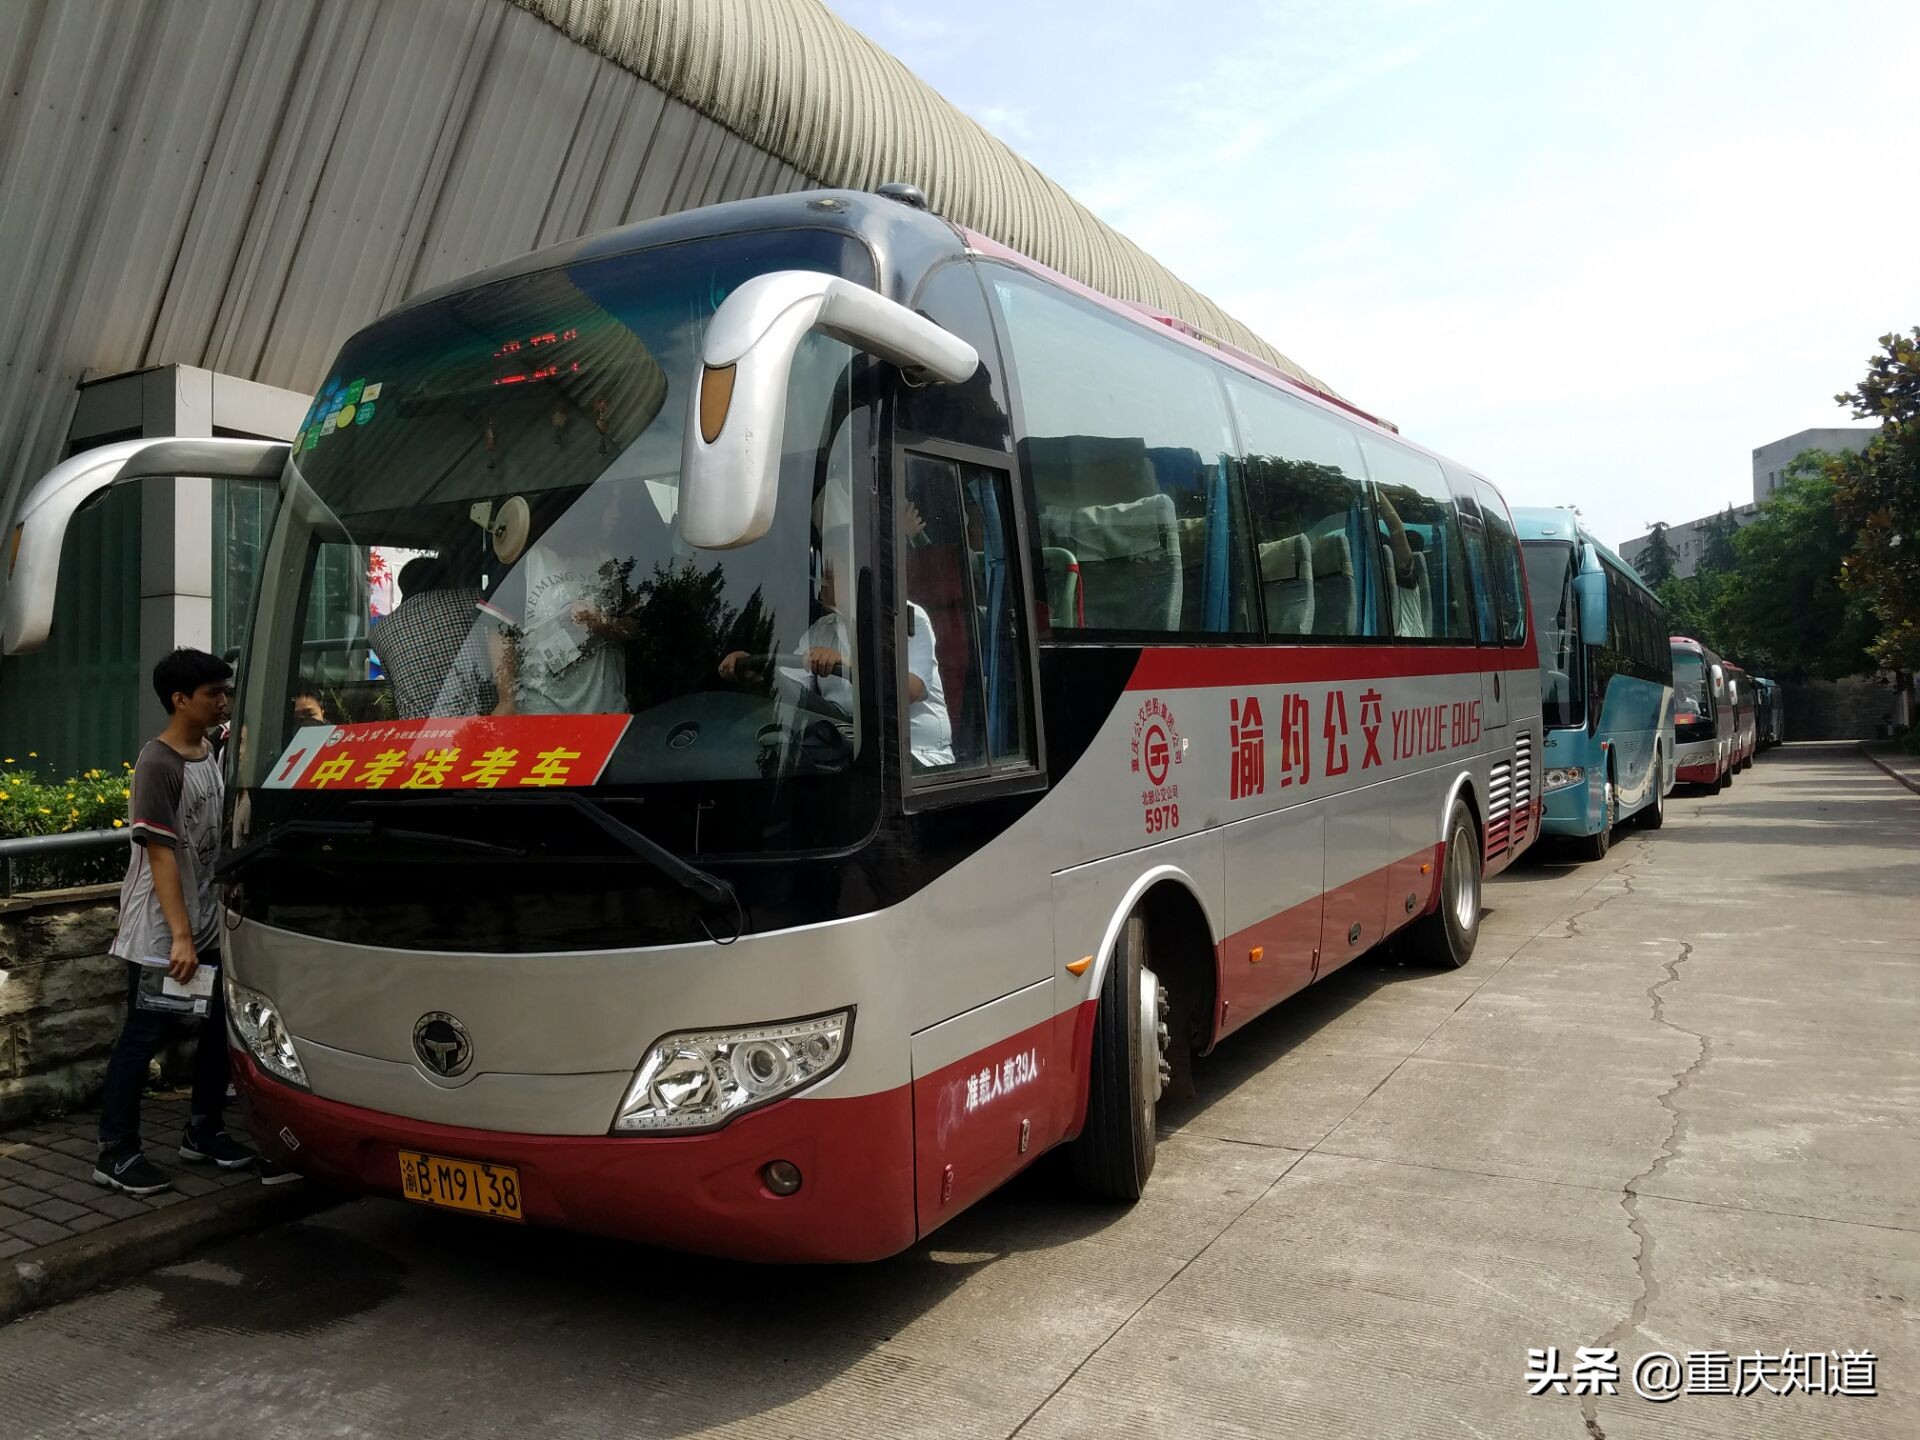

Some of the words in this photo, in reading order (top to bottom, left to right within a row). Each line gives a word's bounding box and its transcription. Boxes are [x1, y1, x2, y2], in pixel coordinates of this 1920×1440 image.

[276, 746, 309, 782] 1
[1230, 688, 1382, 801] 渝约公交
[1391, 704, 1448, 761] YUYUE
[1451, 700, 1481, 748] BUS
[308, 746, 582, 790] 中考送考车
[1145, 803, 1180, 834] 5978
